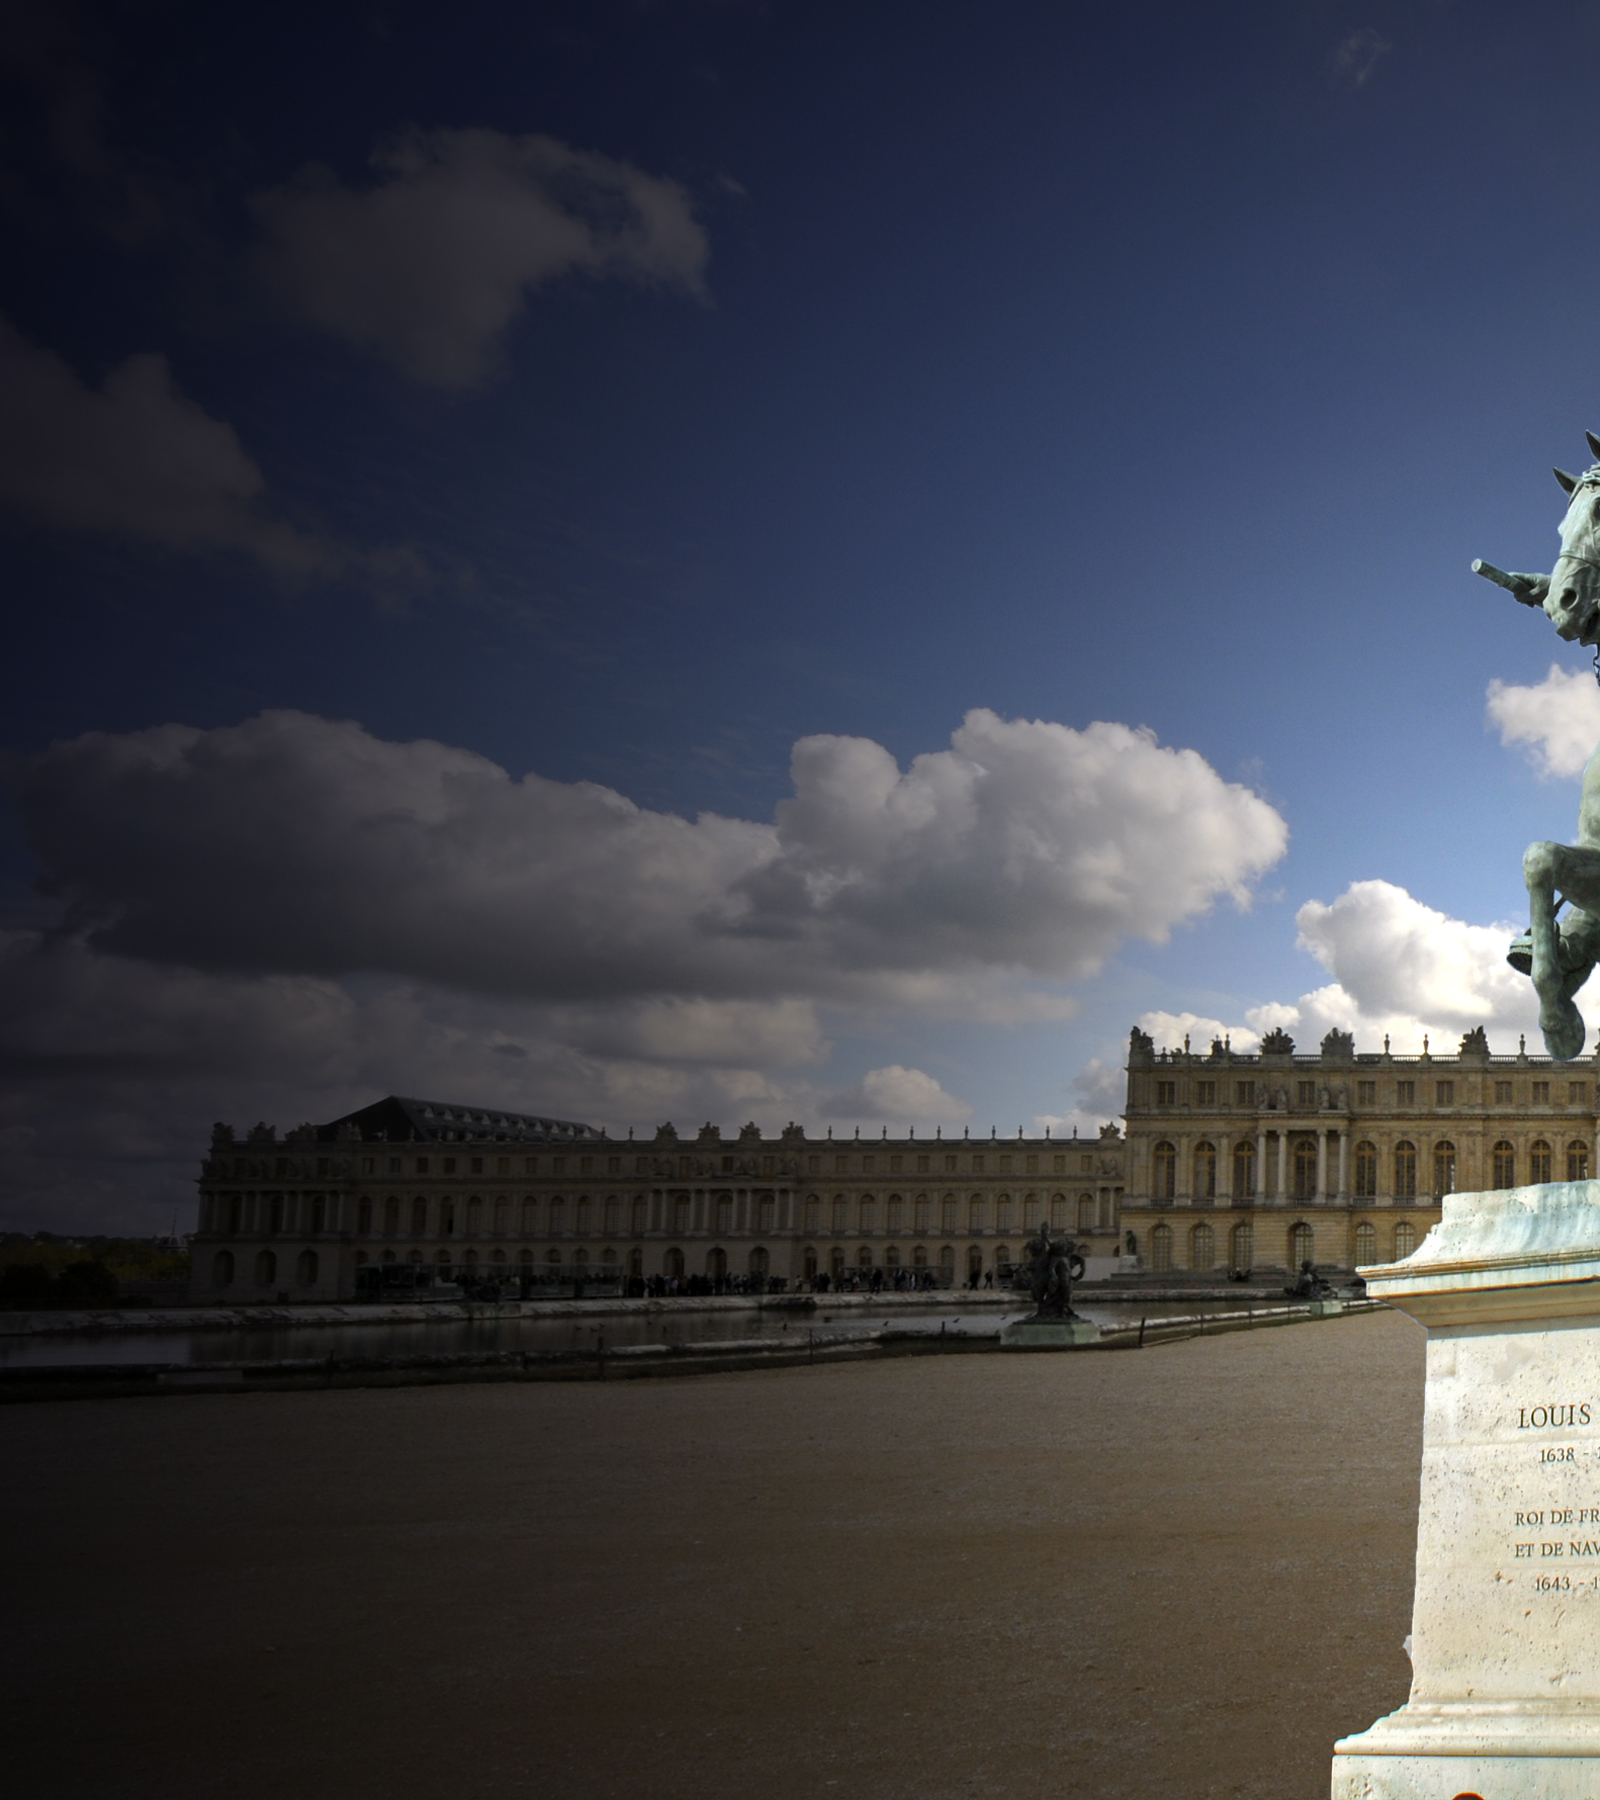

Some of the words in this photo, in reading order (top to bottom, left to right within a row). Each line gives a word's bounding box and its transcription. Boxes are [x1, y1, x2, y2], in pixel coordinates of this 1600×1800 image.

[1517, 1403, 1591, 1429] LOUIS
[1540, 1447, 1575, 1463] 1638
[1515, 1509, 1544, 1525] ROI
[1550, 1509, 1573, 1524] DE
[1515, 1542, 1534, 1558] ET
[1541, 1542, 1563, 1557] DE
[1535, 1576, 1570, 1592] 1643
